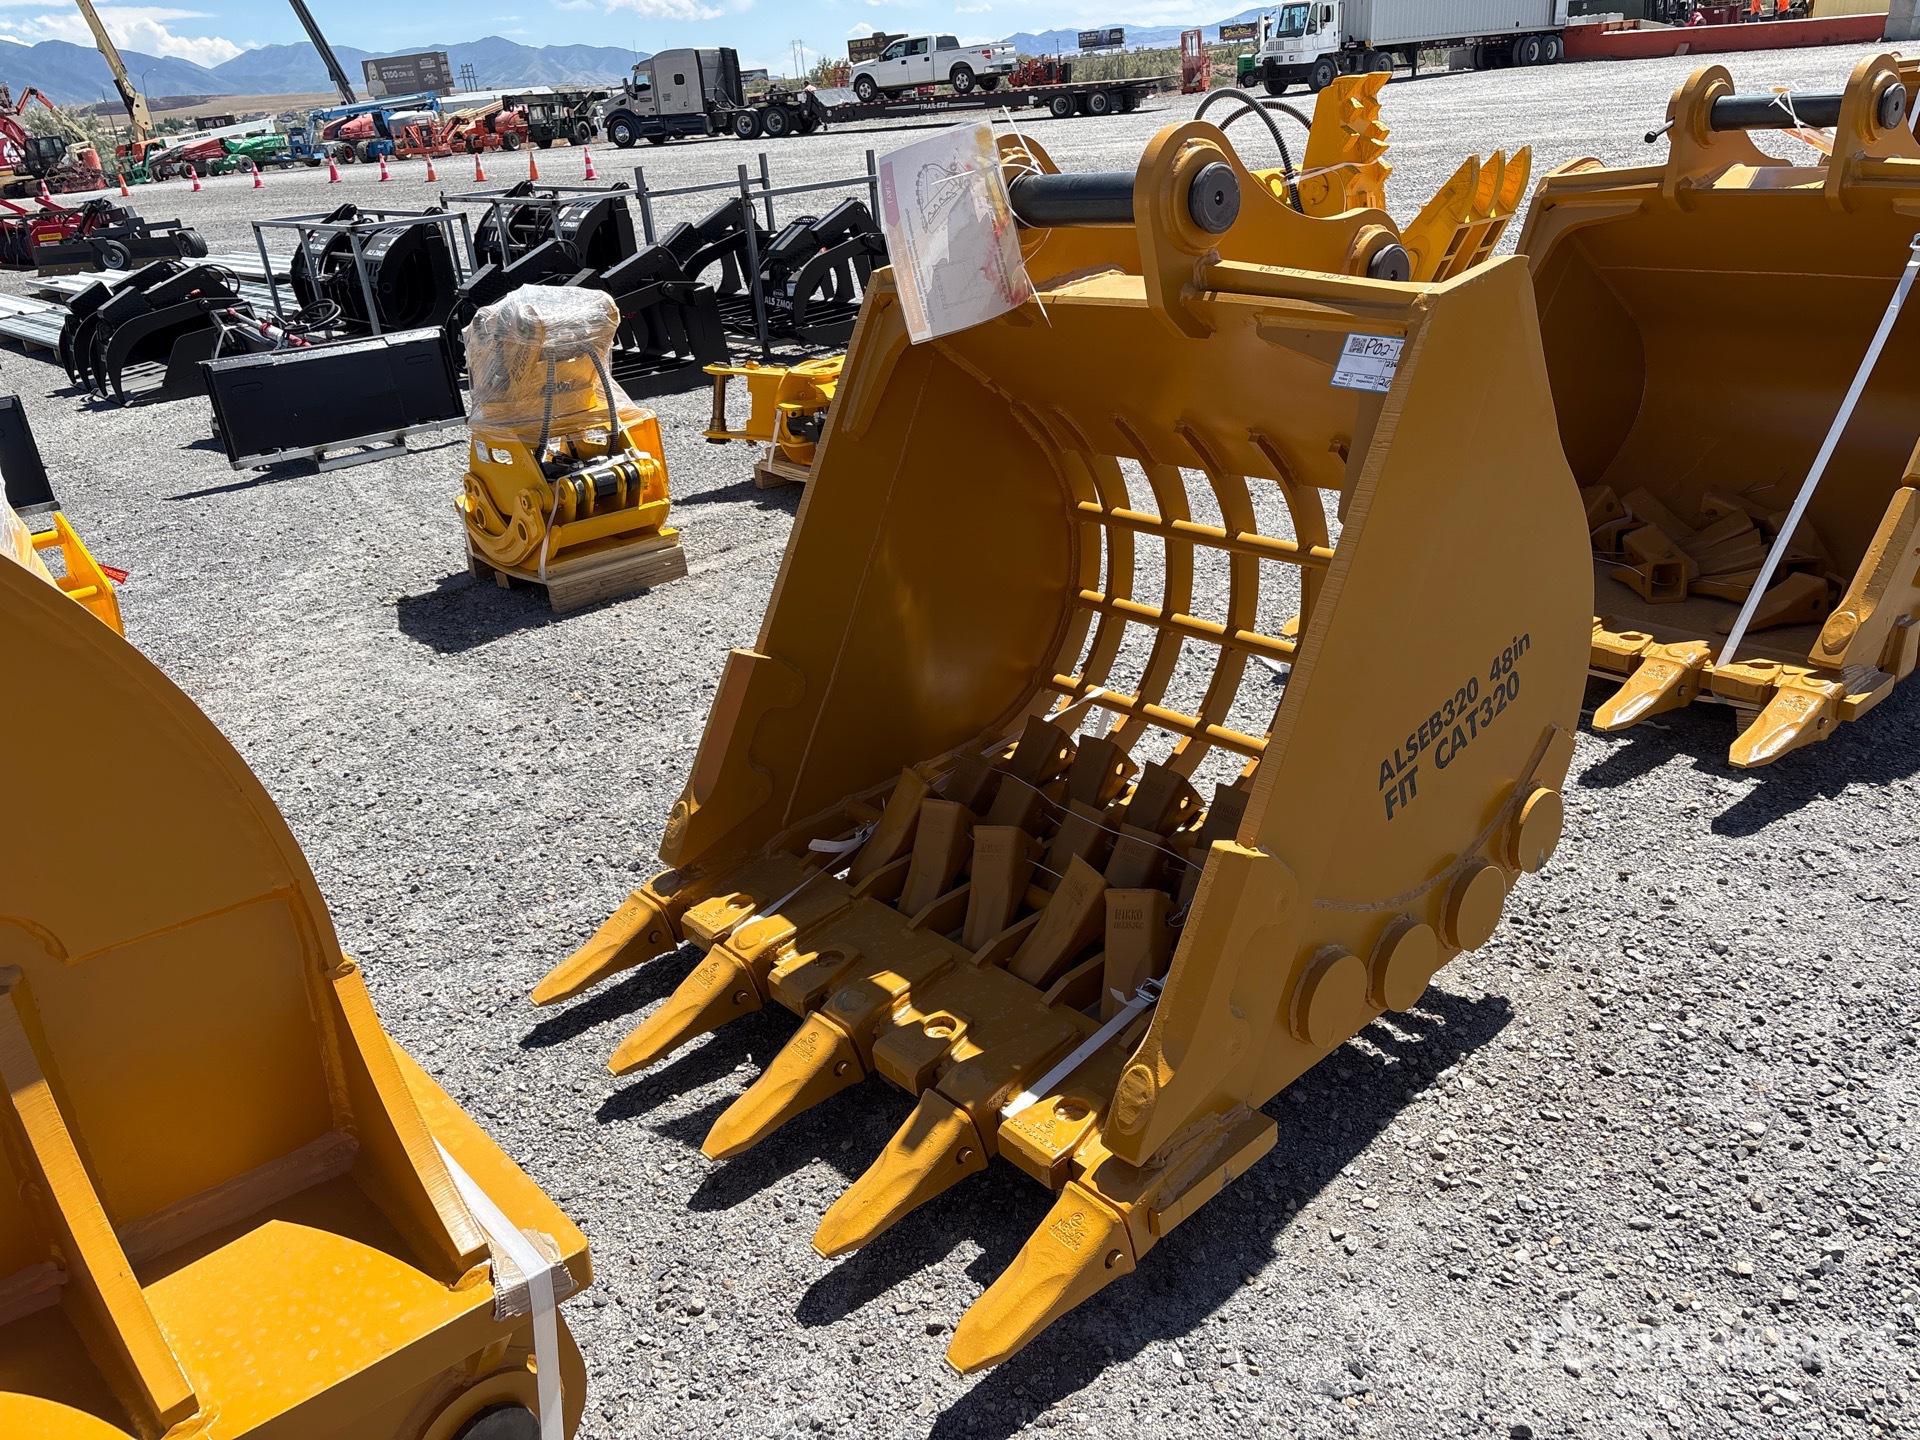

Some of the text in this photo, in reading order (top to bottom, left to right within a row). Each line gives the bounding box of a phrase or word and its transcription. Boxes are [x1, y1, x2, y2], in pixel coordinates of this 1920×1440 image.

[919, 102, 950, 110] TRAIL-EZE
[764, 296, 776, 306] ALS
[1378, 633, 1531, 792] ALSEB320 48in
[1384, 670, 1520, 821] FIT CAT320
[1114, 908, 1142, 920] NIKKO
